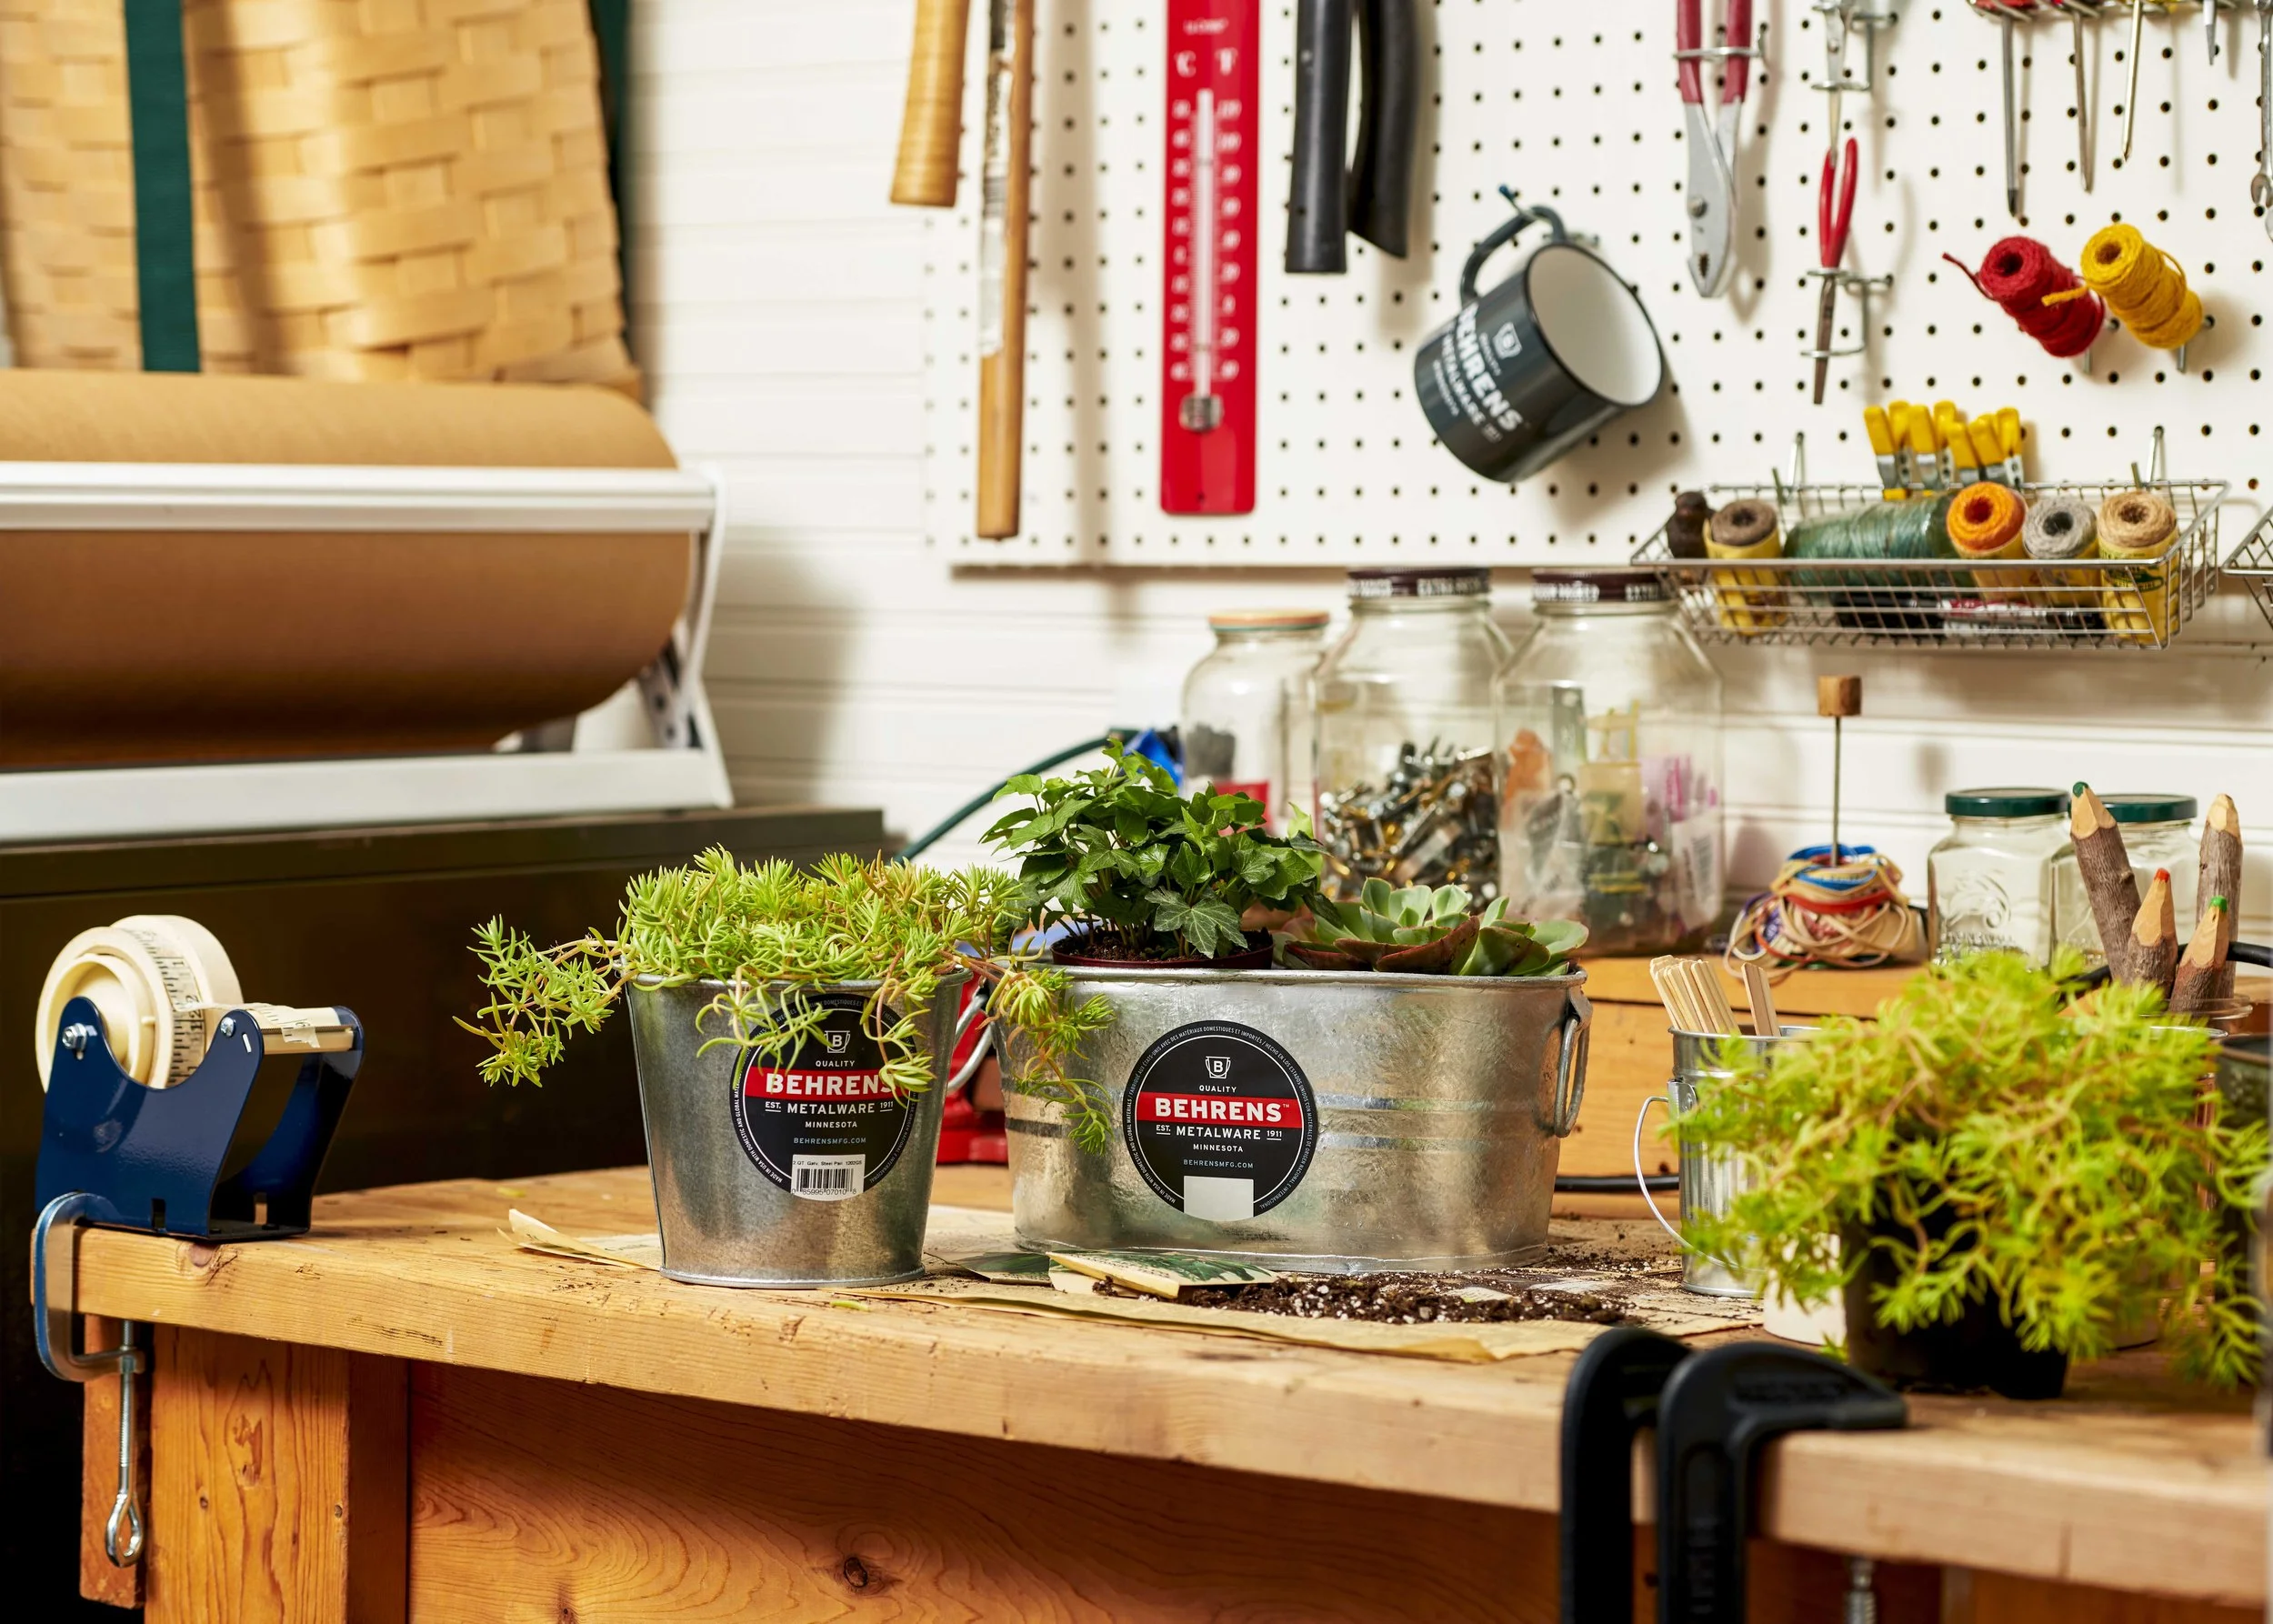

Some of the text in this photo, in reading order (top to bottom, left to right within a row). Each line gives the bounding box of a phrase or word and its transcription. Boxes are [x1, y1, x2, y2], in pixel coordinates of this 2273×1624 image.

[1213, 1061, 1224, 1072] B
[766, 1073, 893, 1096] BEHREN
[1199, 1085, 1237, 1093] QUALITY
[766, 1101, 894, 1115] EST. METALWARE 1911
[1177, 1126, 1261, 1140] METALWARE
[739, 1128, 753, 1151] DOMESTIC
[1193, 1144, 1243, 1153] MINNESOTA
[749, 1149, 760, 1161] WITH
[757, 1159, 766, 1169] USA
[1184, 1159, 1253, 1168] BEHRENSMFG.COM
[770, 1171, 782, 1183] MADE
